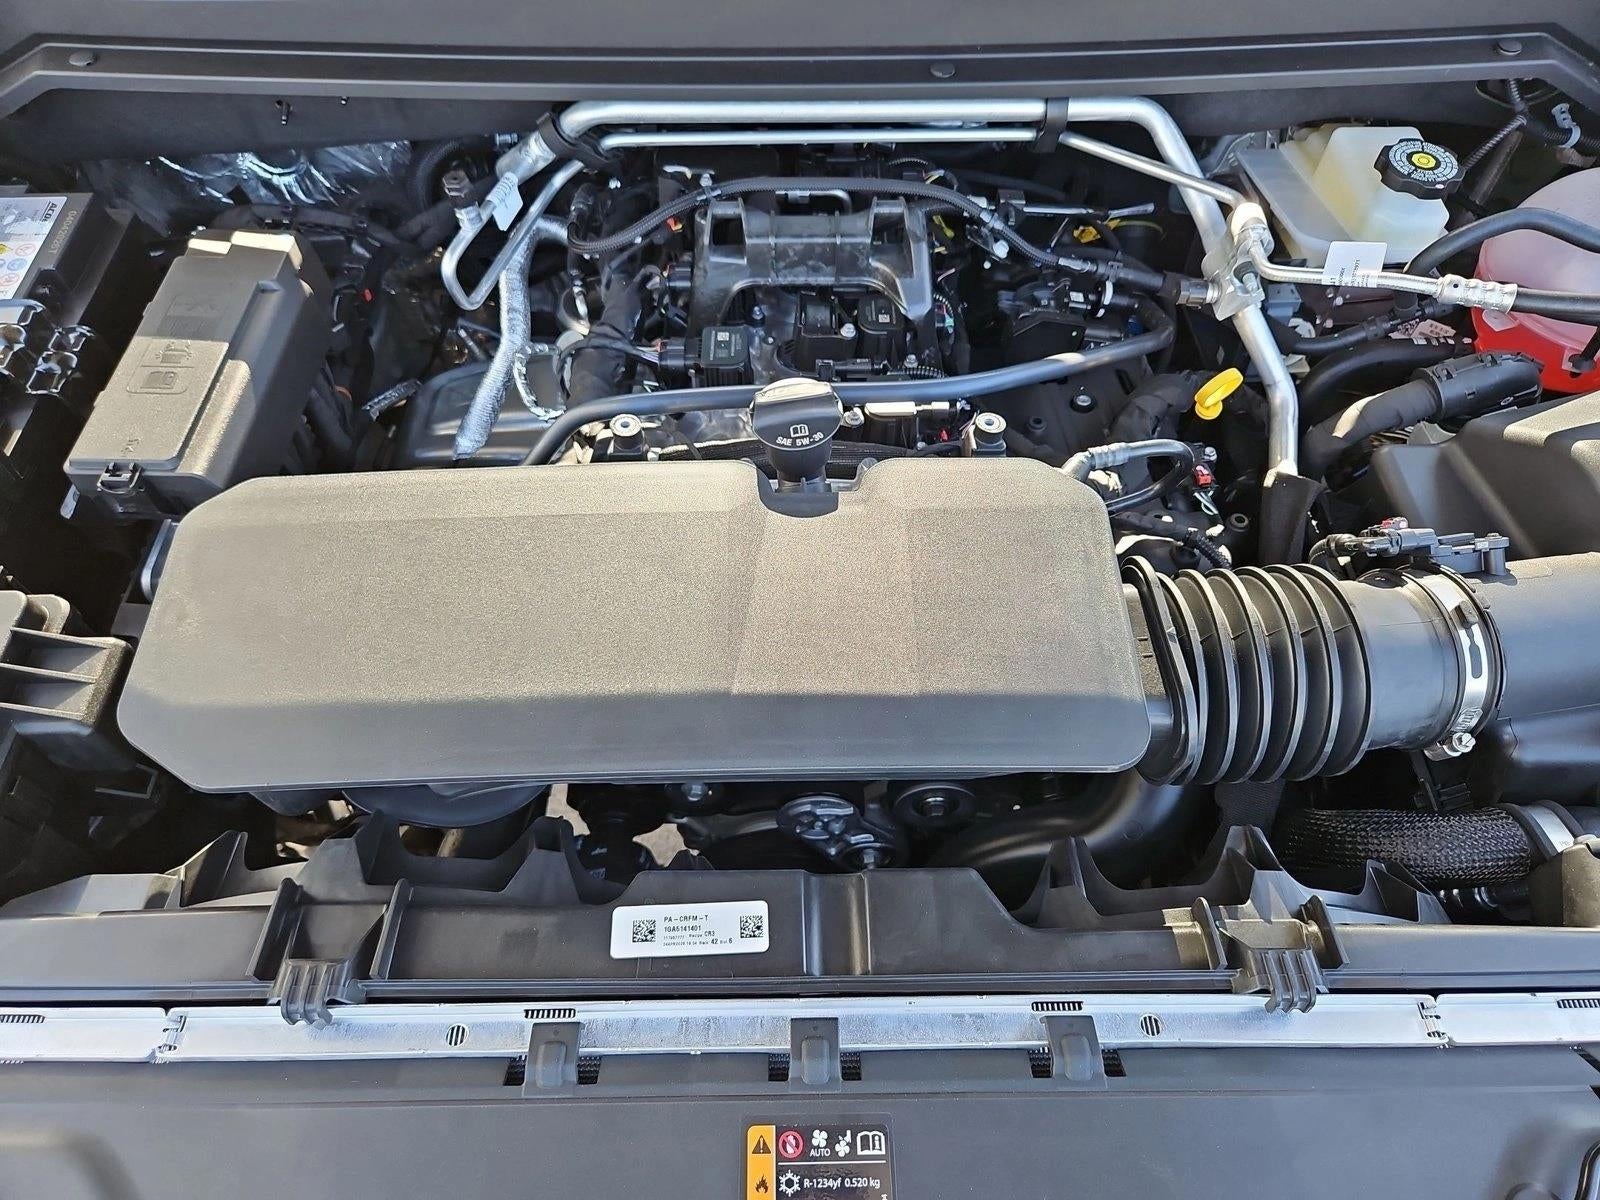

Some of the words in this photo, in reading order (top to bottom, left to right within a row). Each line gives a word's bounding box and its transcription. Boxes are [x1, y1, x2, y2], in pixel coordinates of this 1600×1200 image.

[776, 436, 792, 446] SAE
[796, 431, 824, 446] 5W-30
[809, 1148, 831, 1157] AUTO
[803, 1177, 842, 1190] R-1234yf
[844, 1177, 868, 1188] 0.520
[869, 1176, 880, 1189] kg
